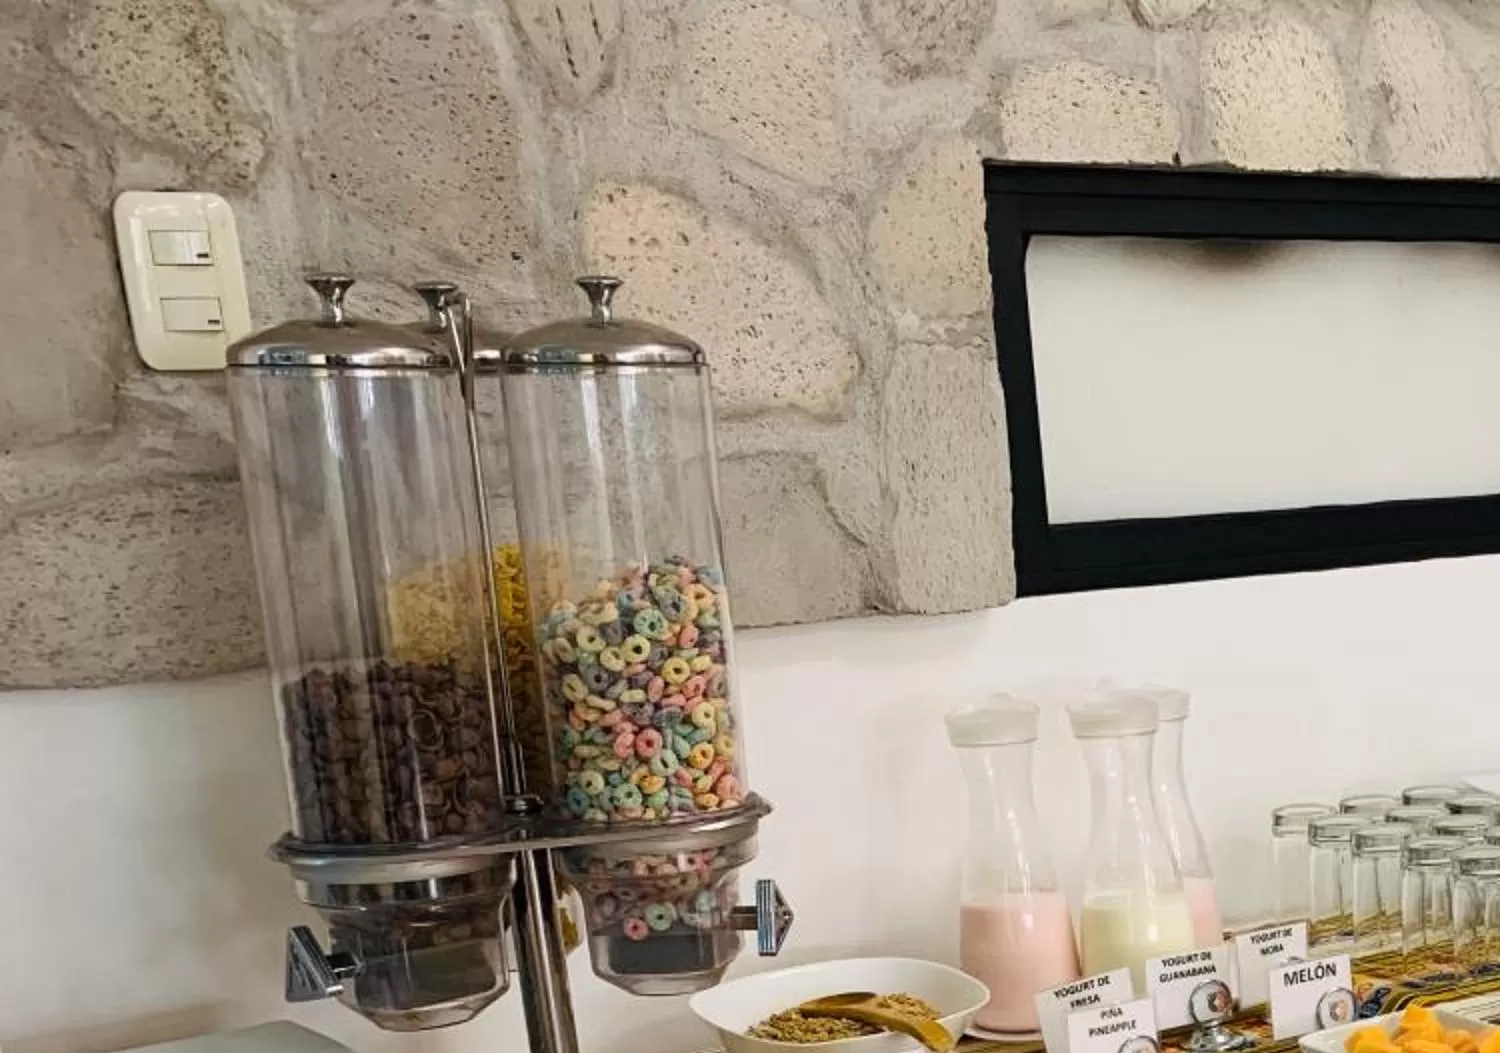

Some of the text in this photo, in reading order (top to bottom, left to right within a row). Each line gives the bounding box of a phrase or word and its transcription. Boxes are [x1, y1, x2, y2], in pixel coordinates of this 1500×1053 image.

[1162, 951, 1212, 968] YOGURT DE
[1283, 961, 1337, 987] MELÓN
[1053, 975, 1111, 999] YOGURT DE
[1069, 993, 1101, 1009] FRESA
[1088, 1019, 1137, 1037] PINEAPPLE
